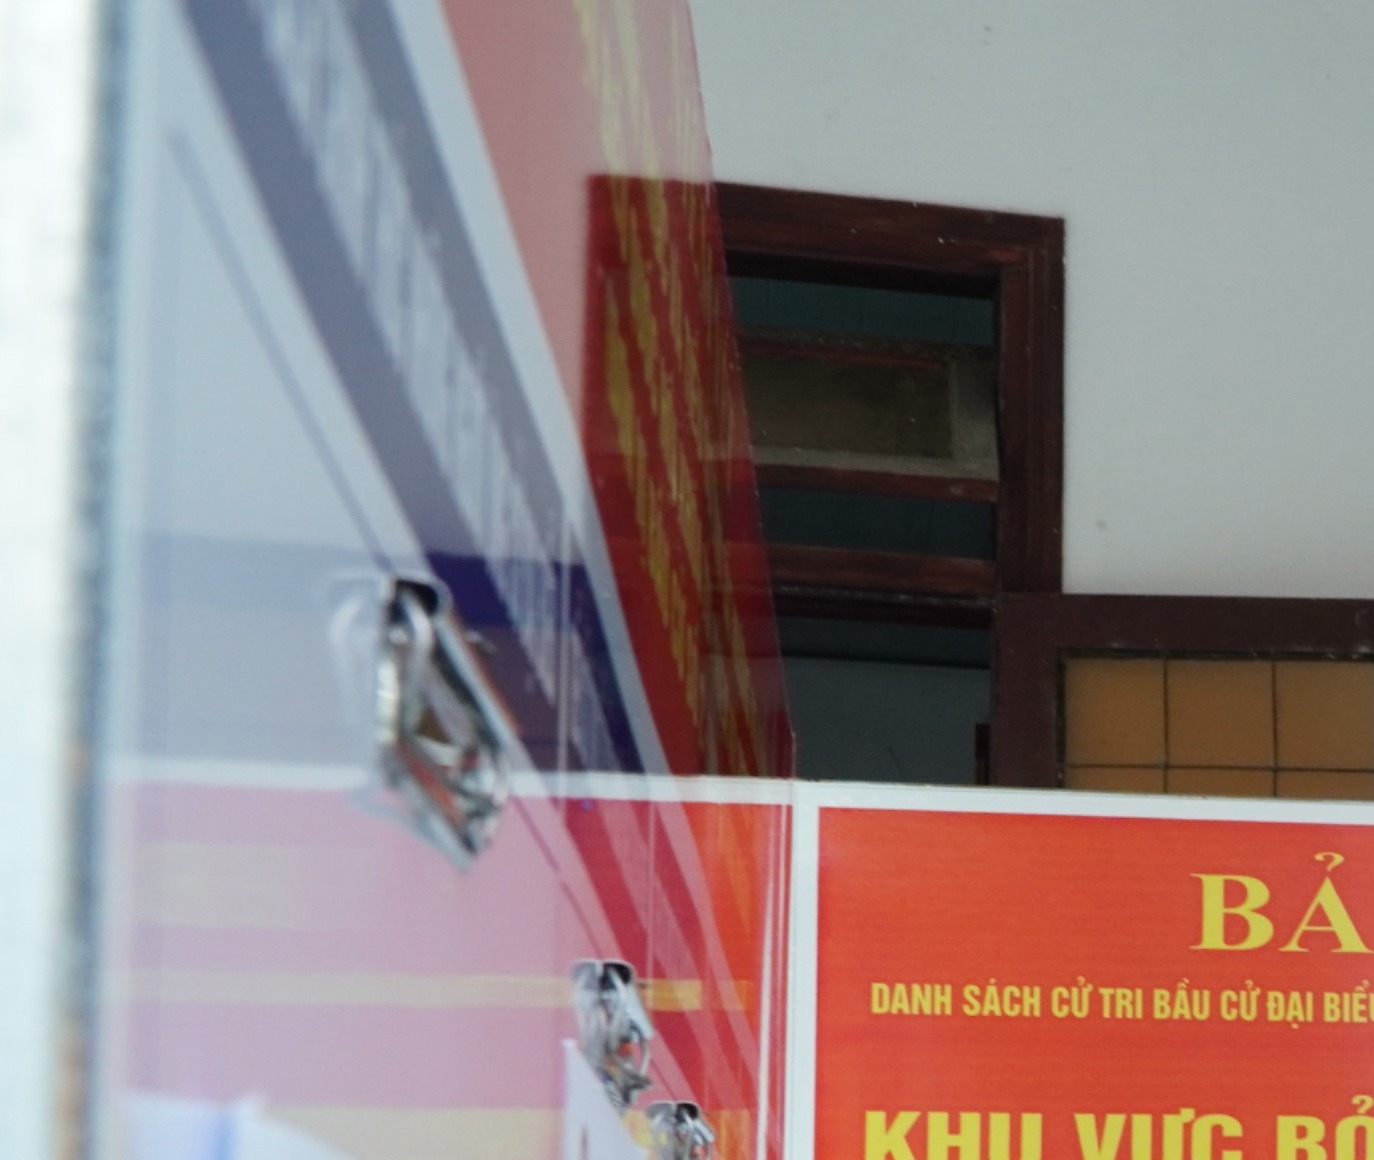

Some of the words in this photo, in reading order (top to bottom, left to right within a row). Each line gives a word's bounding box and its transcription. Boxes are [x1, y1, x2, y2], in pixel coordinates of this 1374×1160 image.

[871, 983, 952, 1015] DANH
[963, 978, 1040, 1017] SÁCH
[1052, 976, 1093, 1017] CỬ
[1099, 988, 1143, 1018] TRI
[1154, 978, 1210, 1019] BẦU
[1221, 980, 1261, 1021] CỬ
[1267, 990, 1314, 1029] ĐẠI
